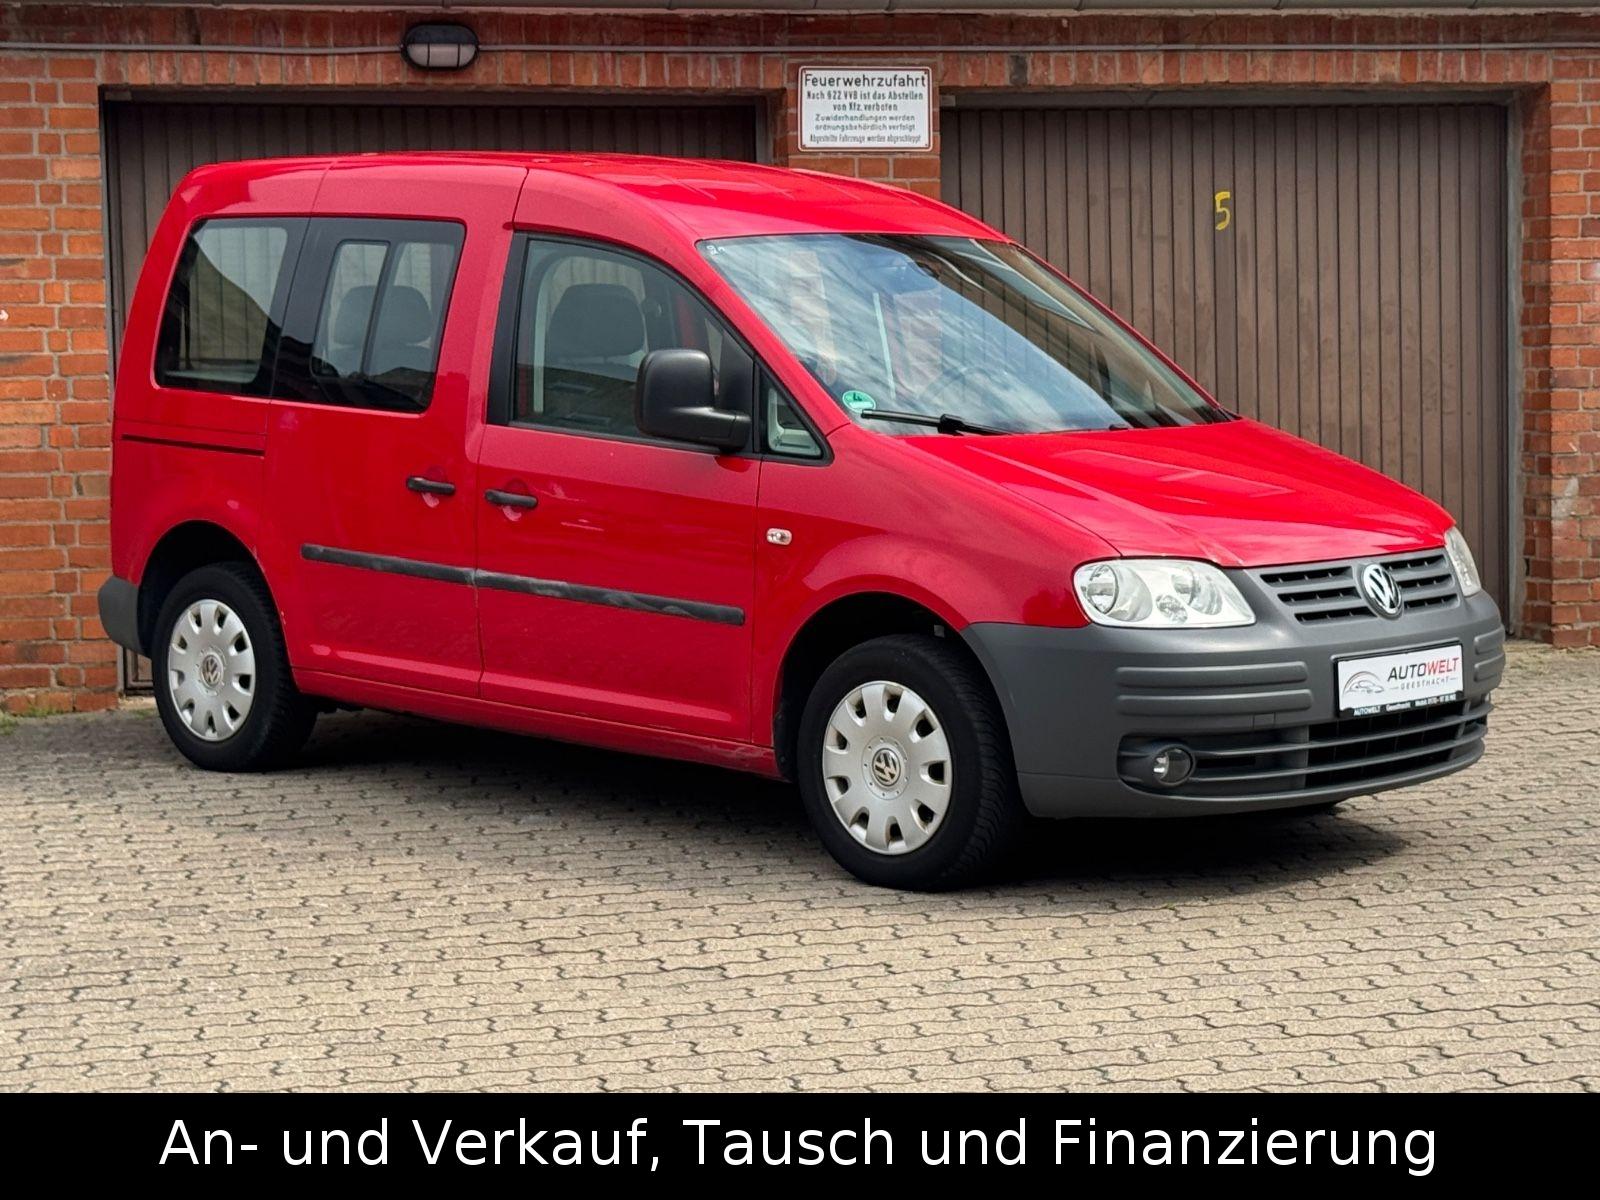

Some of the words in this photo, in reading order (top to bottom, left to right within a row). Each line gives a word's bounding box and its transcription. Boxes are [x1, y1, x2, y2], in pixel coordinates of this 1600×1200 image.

[804, 73, 926, 87] Feuerwehrzufahrt
[807, 91, 825, 100] Nach
[860, 90, 870, 100] ist
[872, 90, 885, 100] das
[888, 90, 923, 100] Abstellen
[833, 103, 847, 111] von
[864, 102, 898, 111] verboten
[815, 114, 887, 122] Zuwiderhandlungen
[1214, 191, 1230, 230] 5
[1387, 657, 1459, 682] AUTOWELT
[1401, 677, 1449, 691] GEESTHACHT
